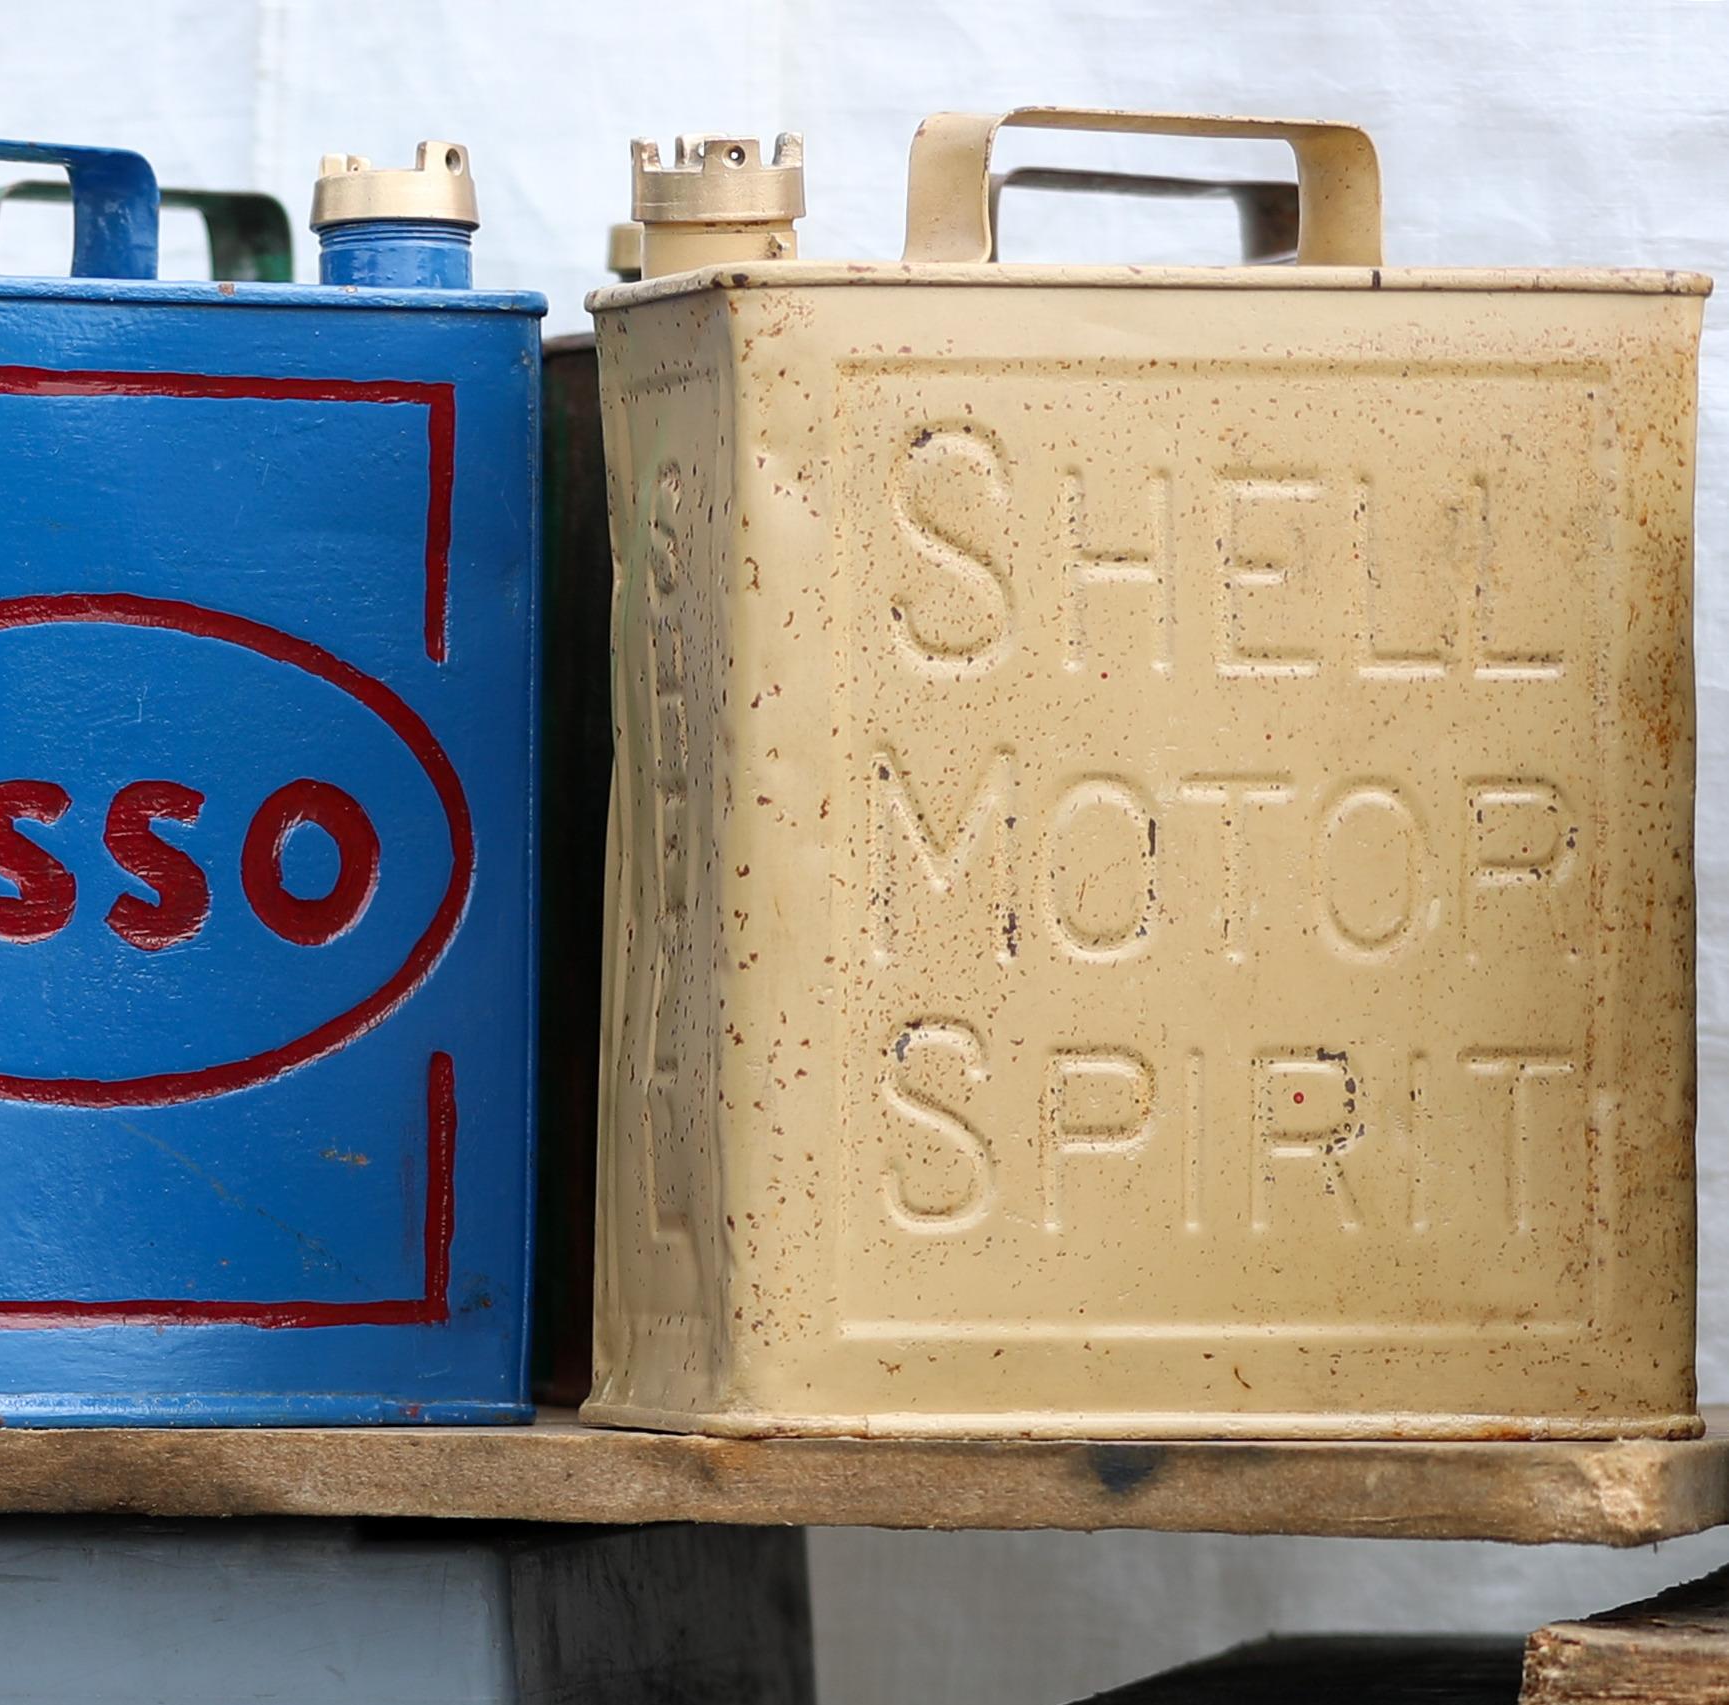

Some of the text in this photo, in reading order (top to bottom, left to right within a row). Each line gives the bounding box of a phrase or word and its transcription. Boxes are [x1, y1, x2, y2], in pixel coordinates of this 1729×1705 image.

[888, 417, 1565, 678] SHELL
[866, 742, 1581, 964] MOTOR
[878, 1012, 1576, 1236] SPIRIT
